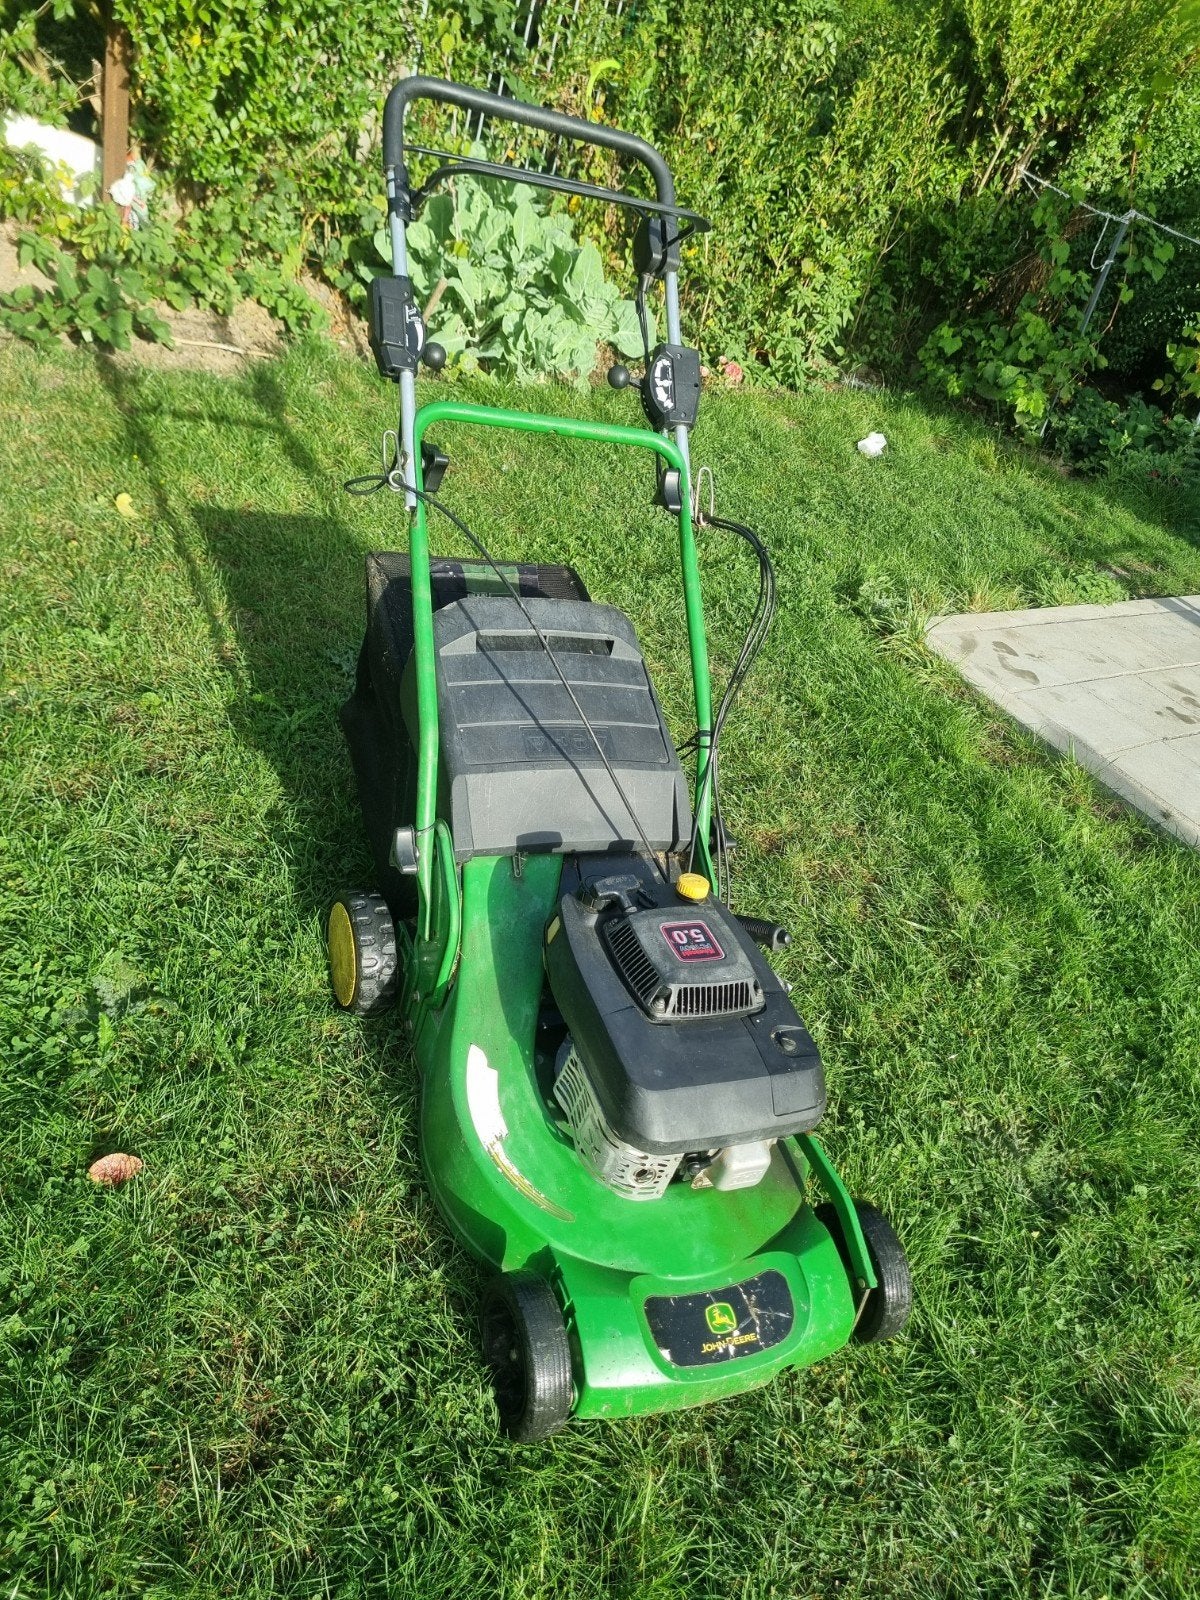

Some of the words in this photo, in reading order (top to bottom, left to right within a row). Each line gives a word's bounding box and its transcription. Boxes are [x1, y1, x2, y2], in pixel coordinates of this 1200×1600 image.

[671, 929, 706, 944] 5.0
[701, 1340, 727, 1353] JOHN
[726, 1333, 757, 1346] DEERE
